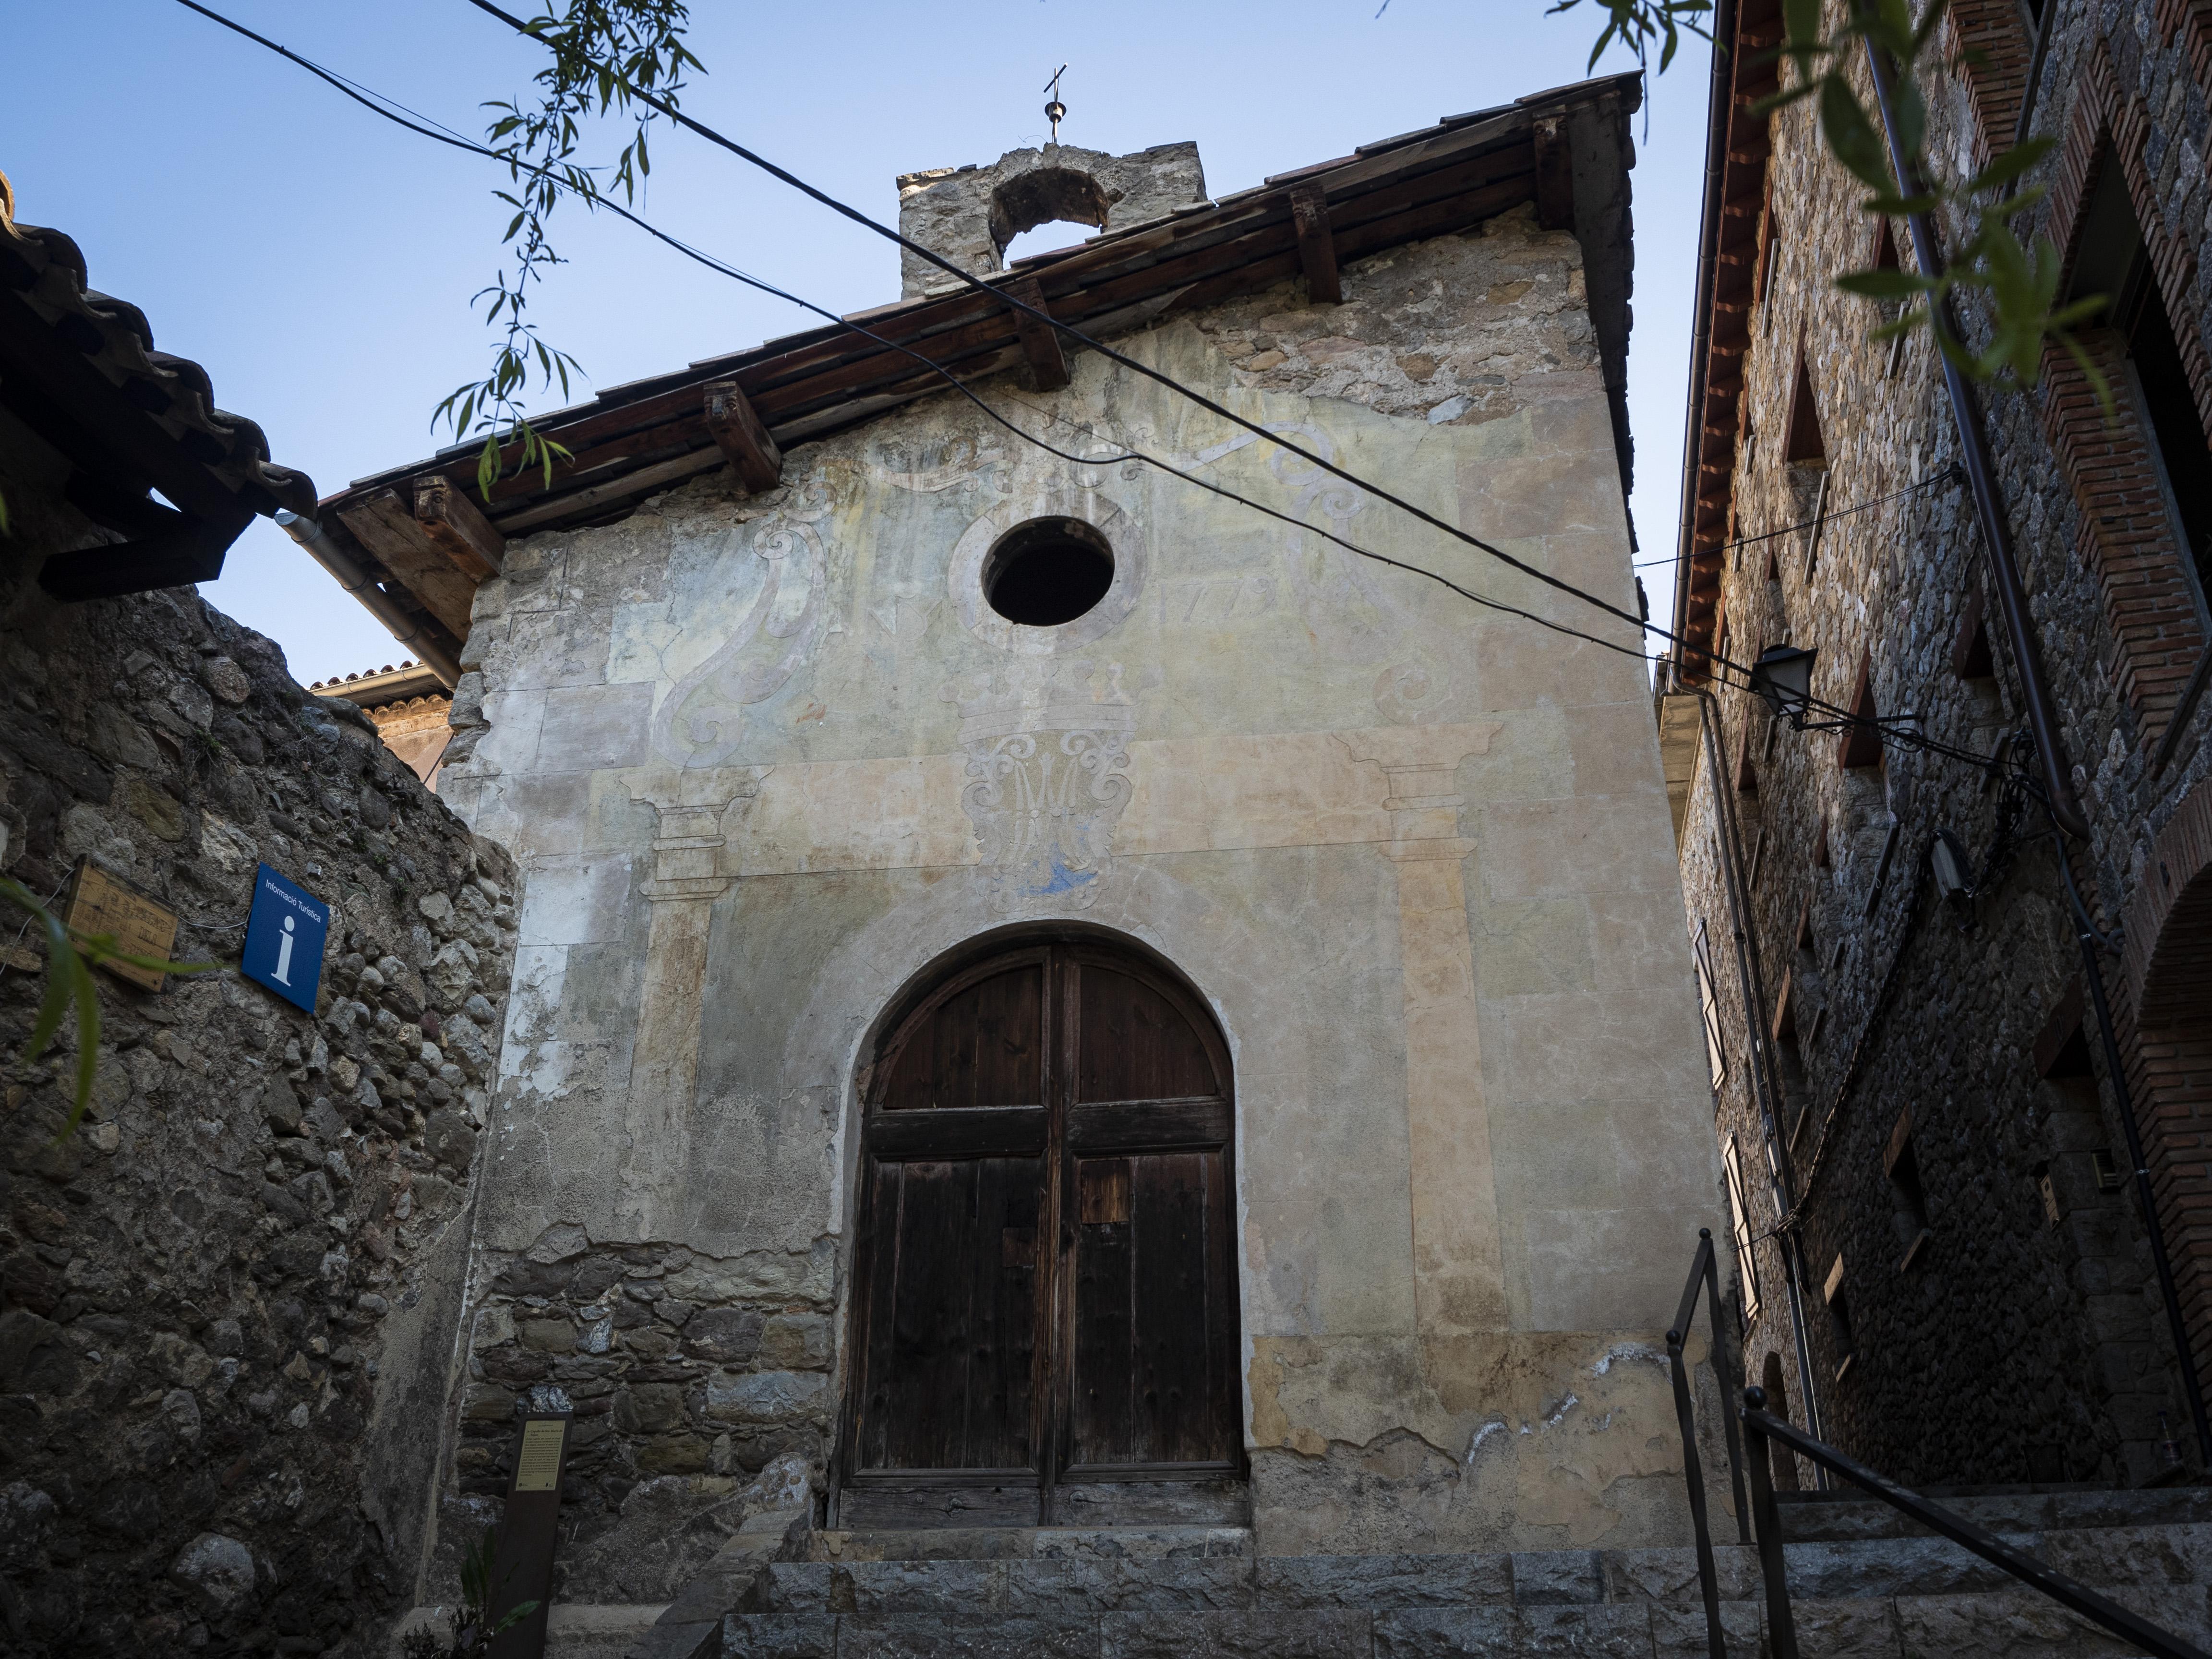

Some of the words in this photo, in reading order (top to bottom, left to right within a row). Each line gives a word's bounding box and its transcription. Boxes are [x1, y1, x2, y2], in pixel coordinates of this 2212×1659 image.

[1159, 577, 1275, 623] 1779
[265, 879, 297, 906] Informació
[298, 901, 321, 923] Turística
